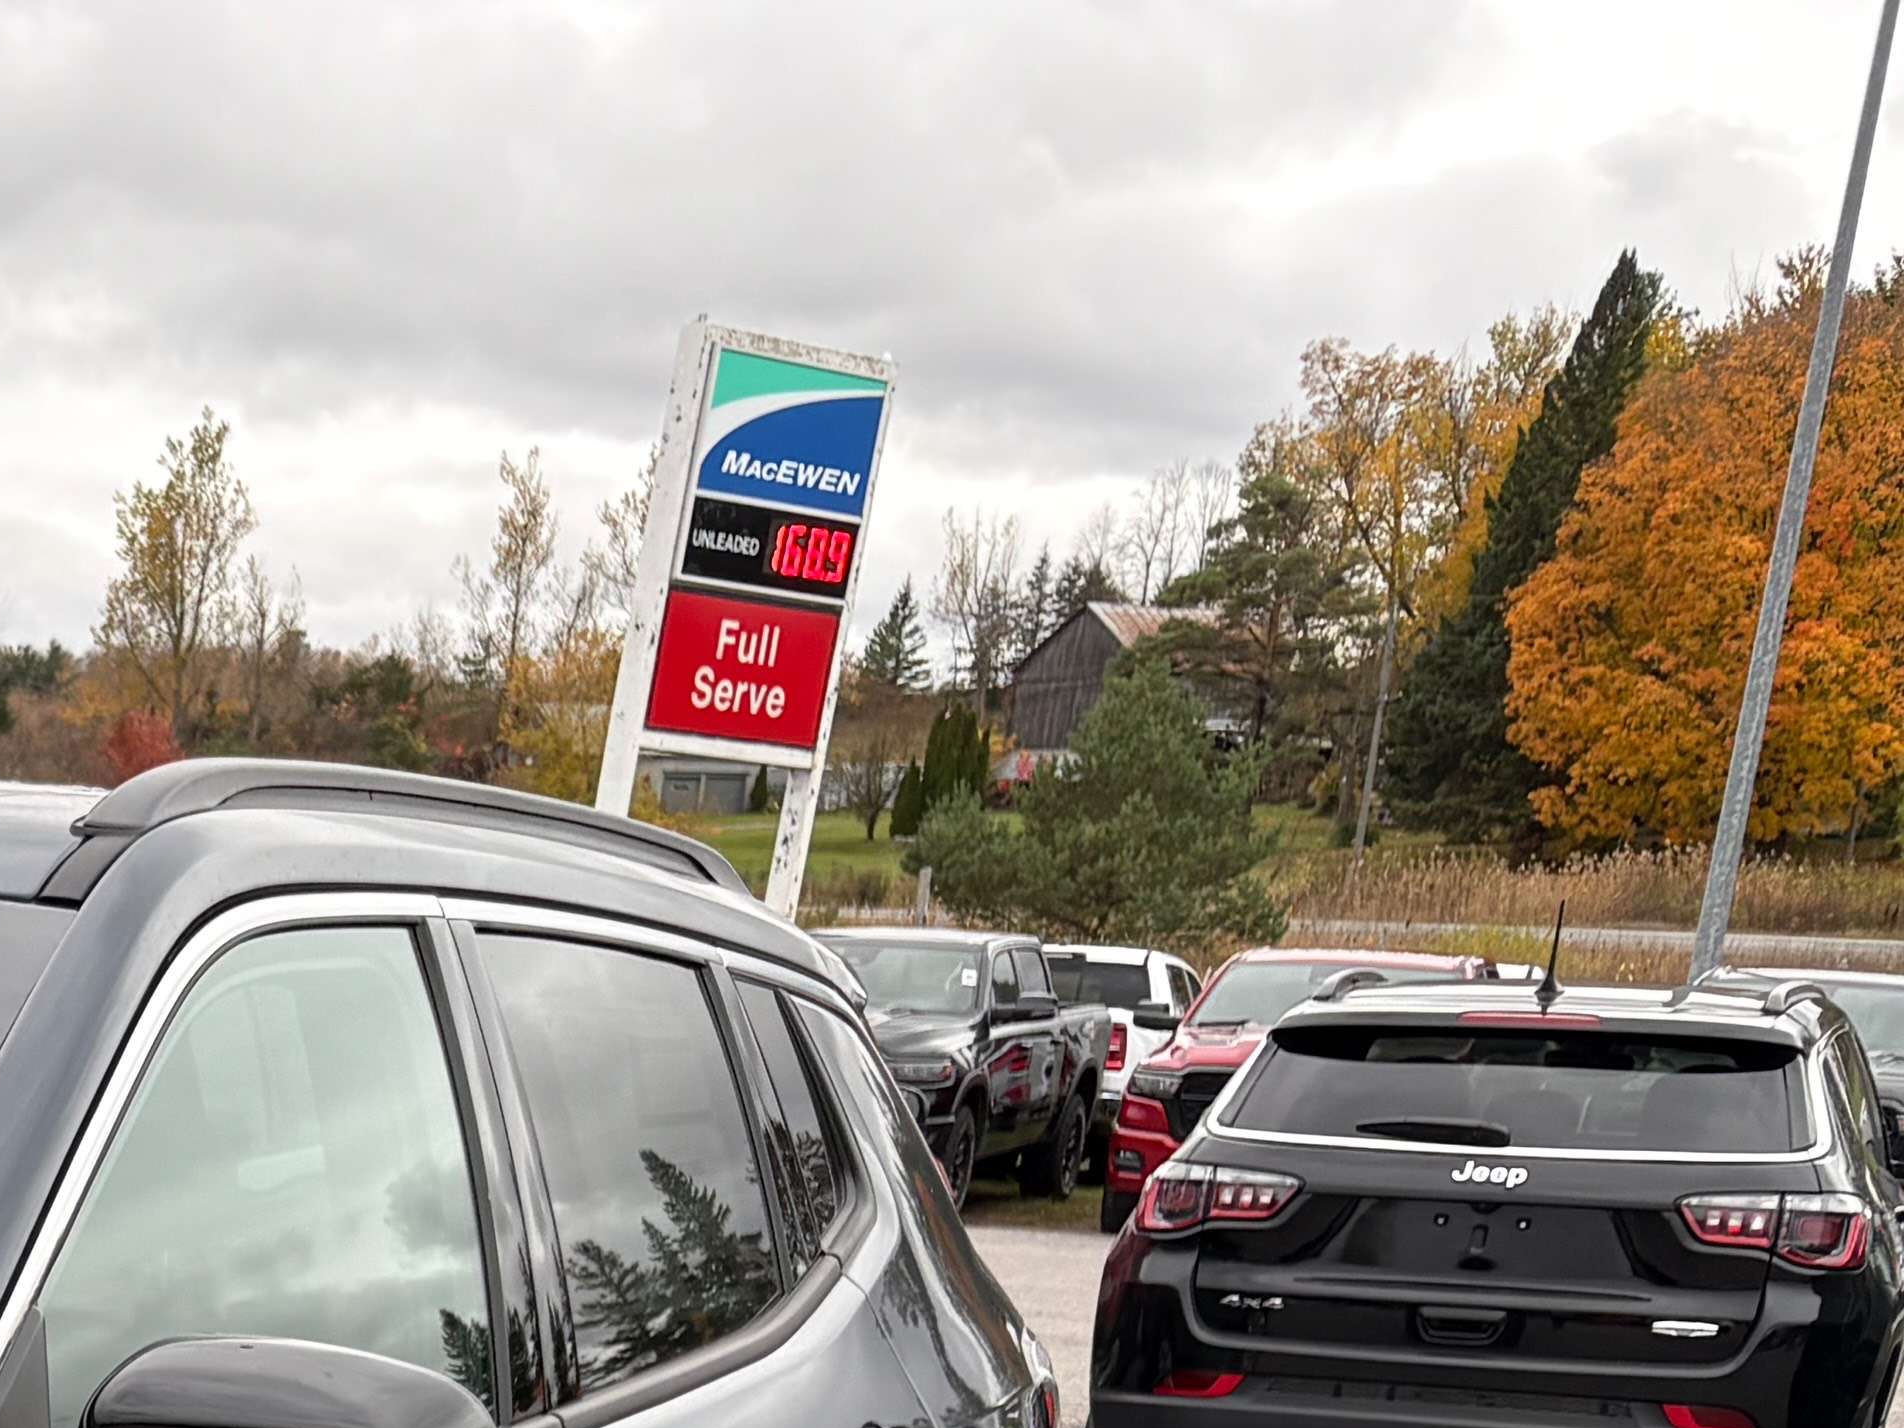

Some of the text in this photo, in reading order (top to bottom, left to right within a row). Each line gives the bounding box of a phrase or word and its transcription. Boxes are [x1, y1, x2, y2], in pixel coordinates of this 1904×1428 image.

[692, 527, 760, 557] UNLEADED
[715, 617, 781, 668] Full
[691, 664, 786, 719] Serve
[1451, 1160, 1529, 1189] Jeep
